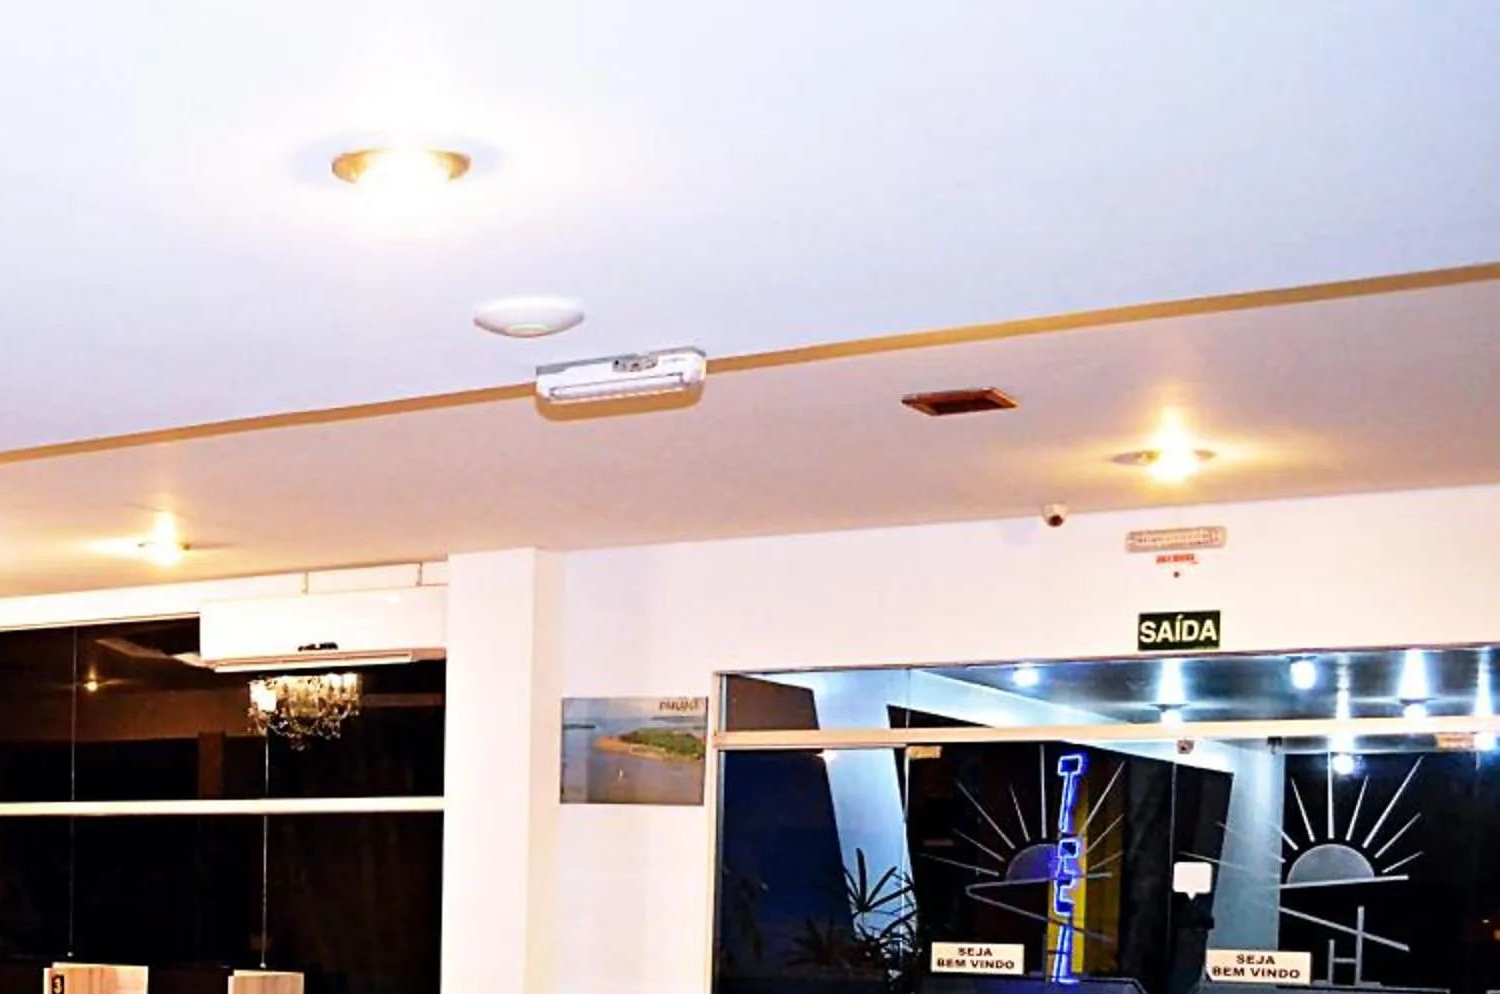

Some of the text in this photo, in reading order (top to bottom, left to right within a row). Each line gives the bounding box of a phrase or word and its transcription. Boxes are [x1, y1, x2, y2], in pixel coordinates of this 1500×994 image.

[1139, 614, 1218, 643] SAÍDA
[957, 947, 993, 957] SEJA
[937, 958, 1015, 970] BEM VINDO
[1236, 953, 1276, 965] SEJA
[1211, 965, 1301, 979] BEM VINDO
